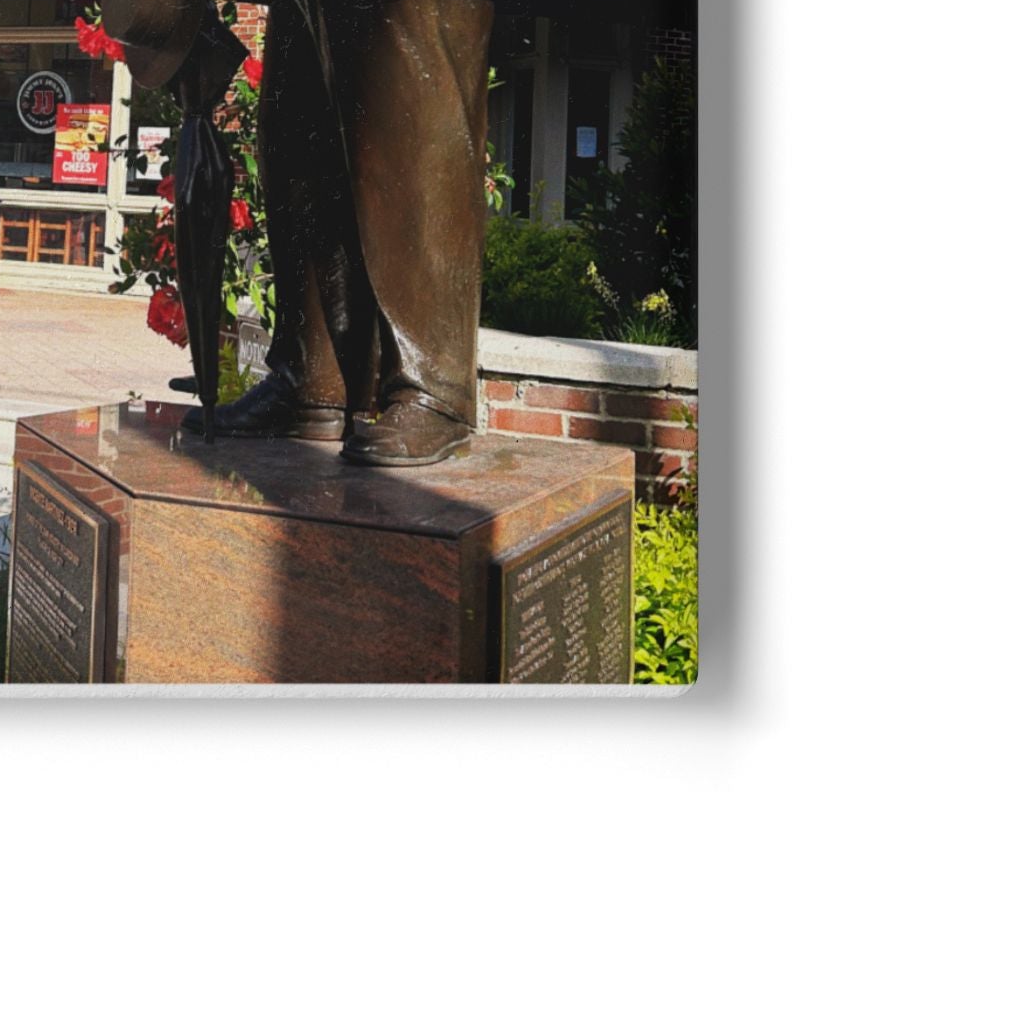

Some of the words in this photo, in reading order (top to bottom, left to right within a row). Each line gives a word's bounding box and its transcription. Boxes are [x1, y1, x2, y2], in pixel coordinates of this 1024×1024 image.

[71, 150, 91, 162] TOO
[62, 161, 98, 174] CHEESY
[239, 338, 270, 366] NOTIC
